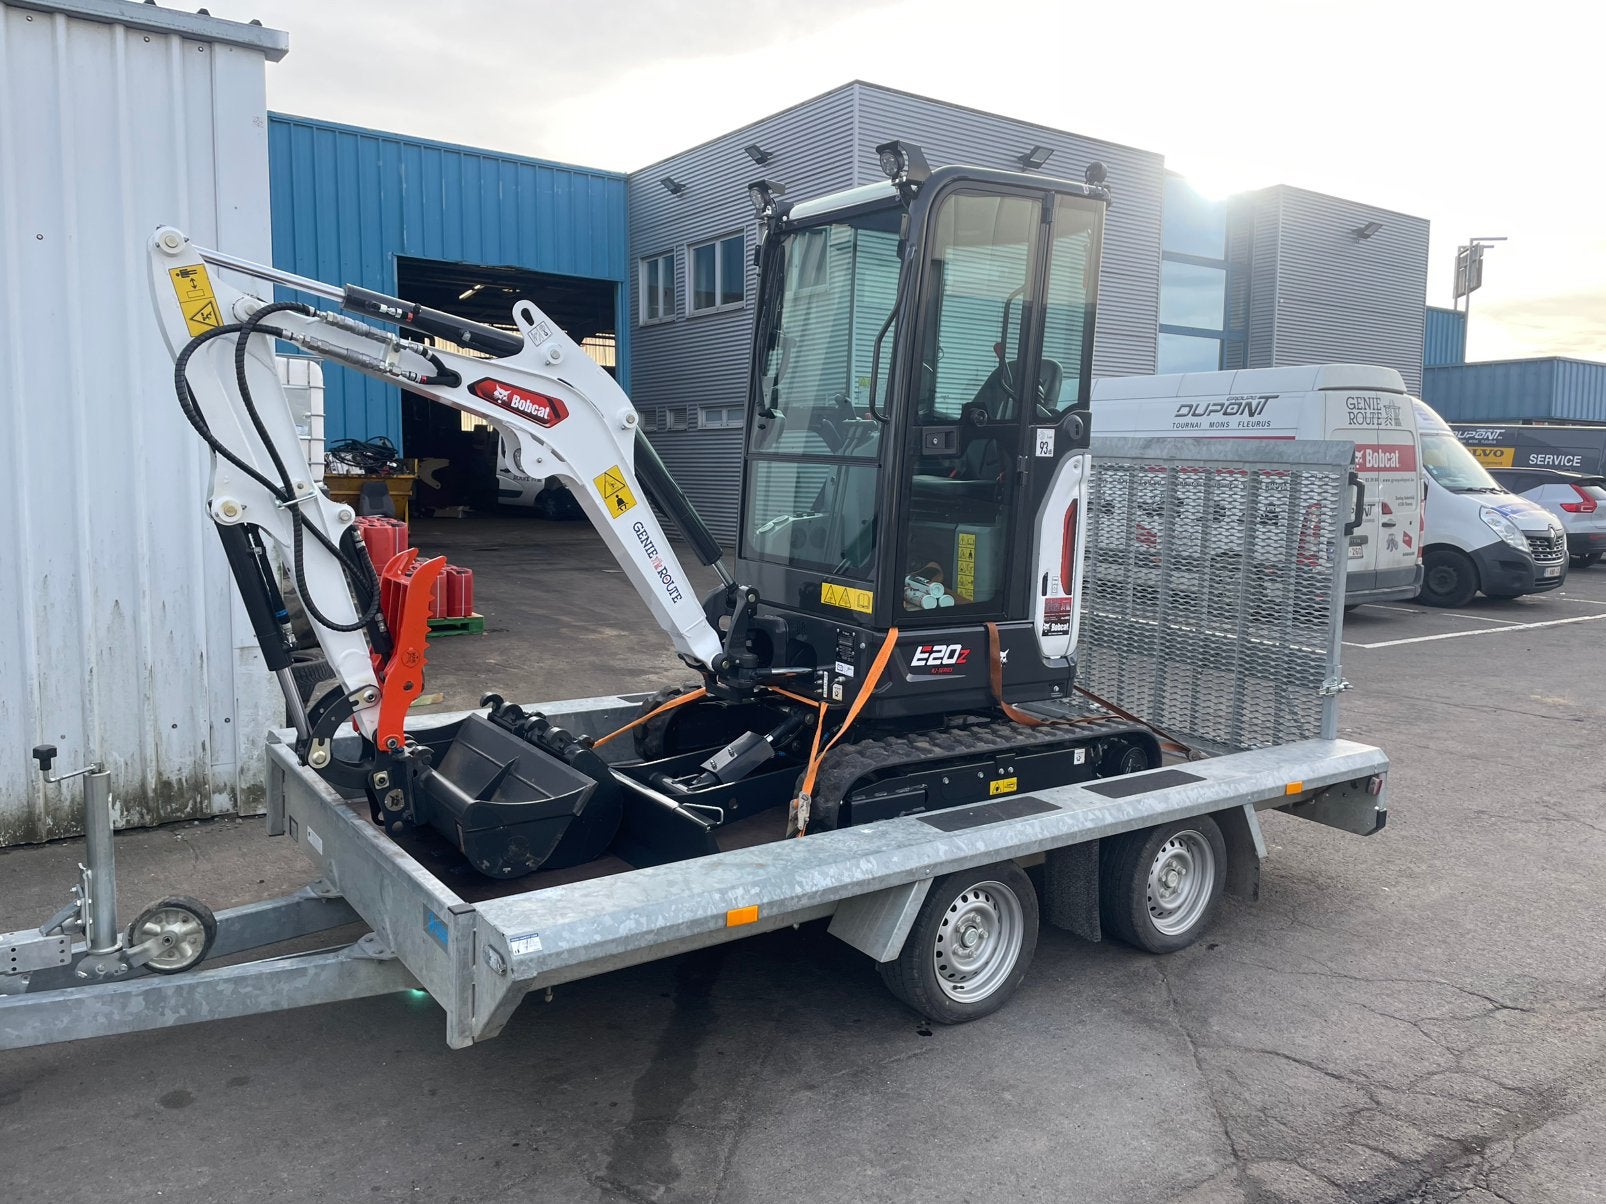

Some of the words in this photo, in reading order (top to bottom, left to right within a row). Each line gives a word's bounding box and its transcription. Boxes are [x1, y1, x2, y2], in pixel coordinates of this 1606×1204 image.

[511, 394, 549, 420] Bobcat
[1174, 394, 1280, 417] DUPONT
[1346, 397, 1382, 411] GENIE
[1238, 420, 1271, 428] FLEURUS
[1348, 411, 1383, 426] ROUTE
[1040, 441, 1048, 455] 93
[1468, 448, 1504, 457] LVO
[1366, 448, 1400, 468] Bobcat
[1529, 454, 1582, 466] SERVICE
[632, 521, 659, 559] GENIE
[657, 566, 683, 604] ROUTE
[1050, 622, 1069, 631] Bobcat
